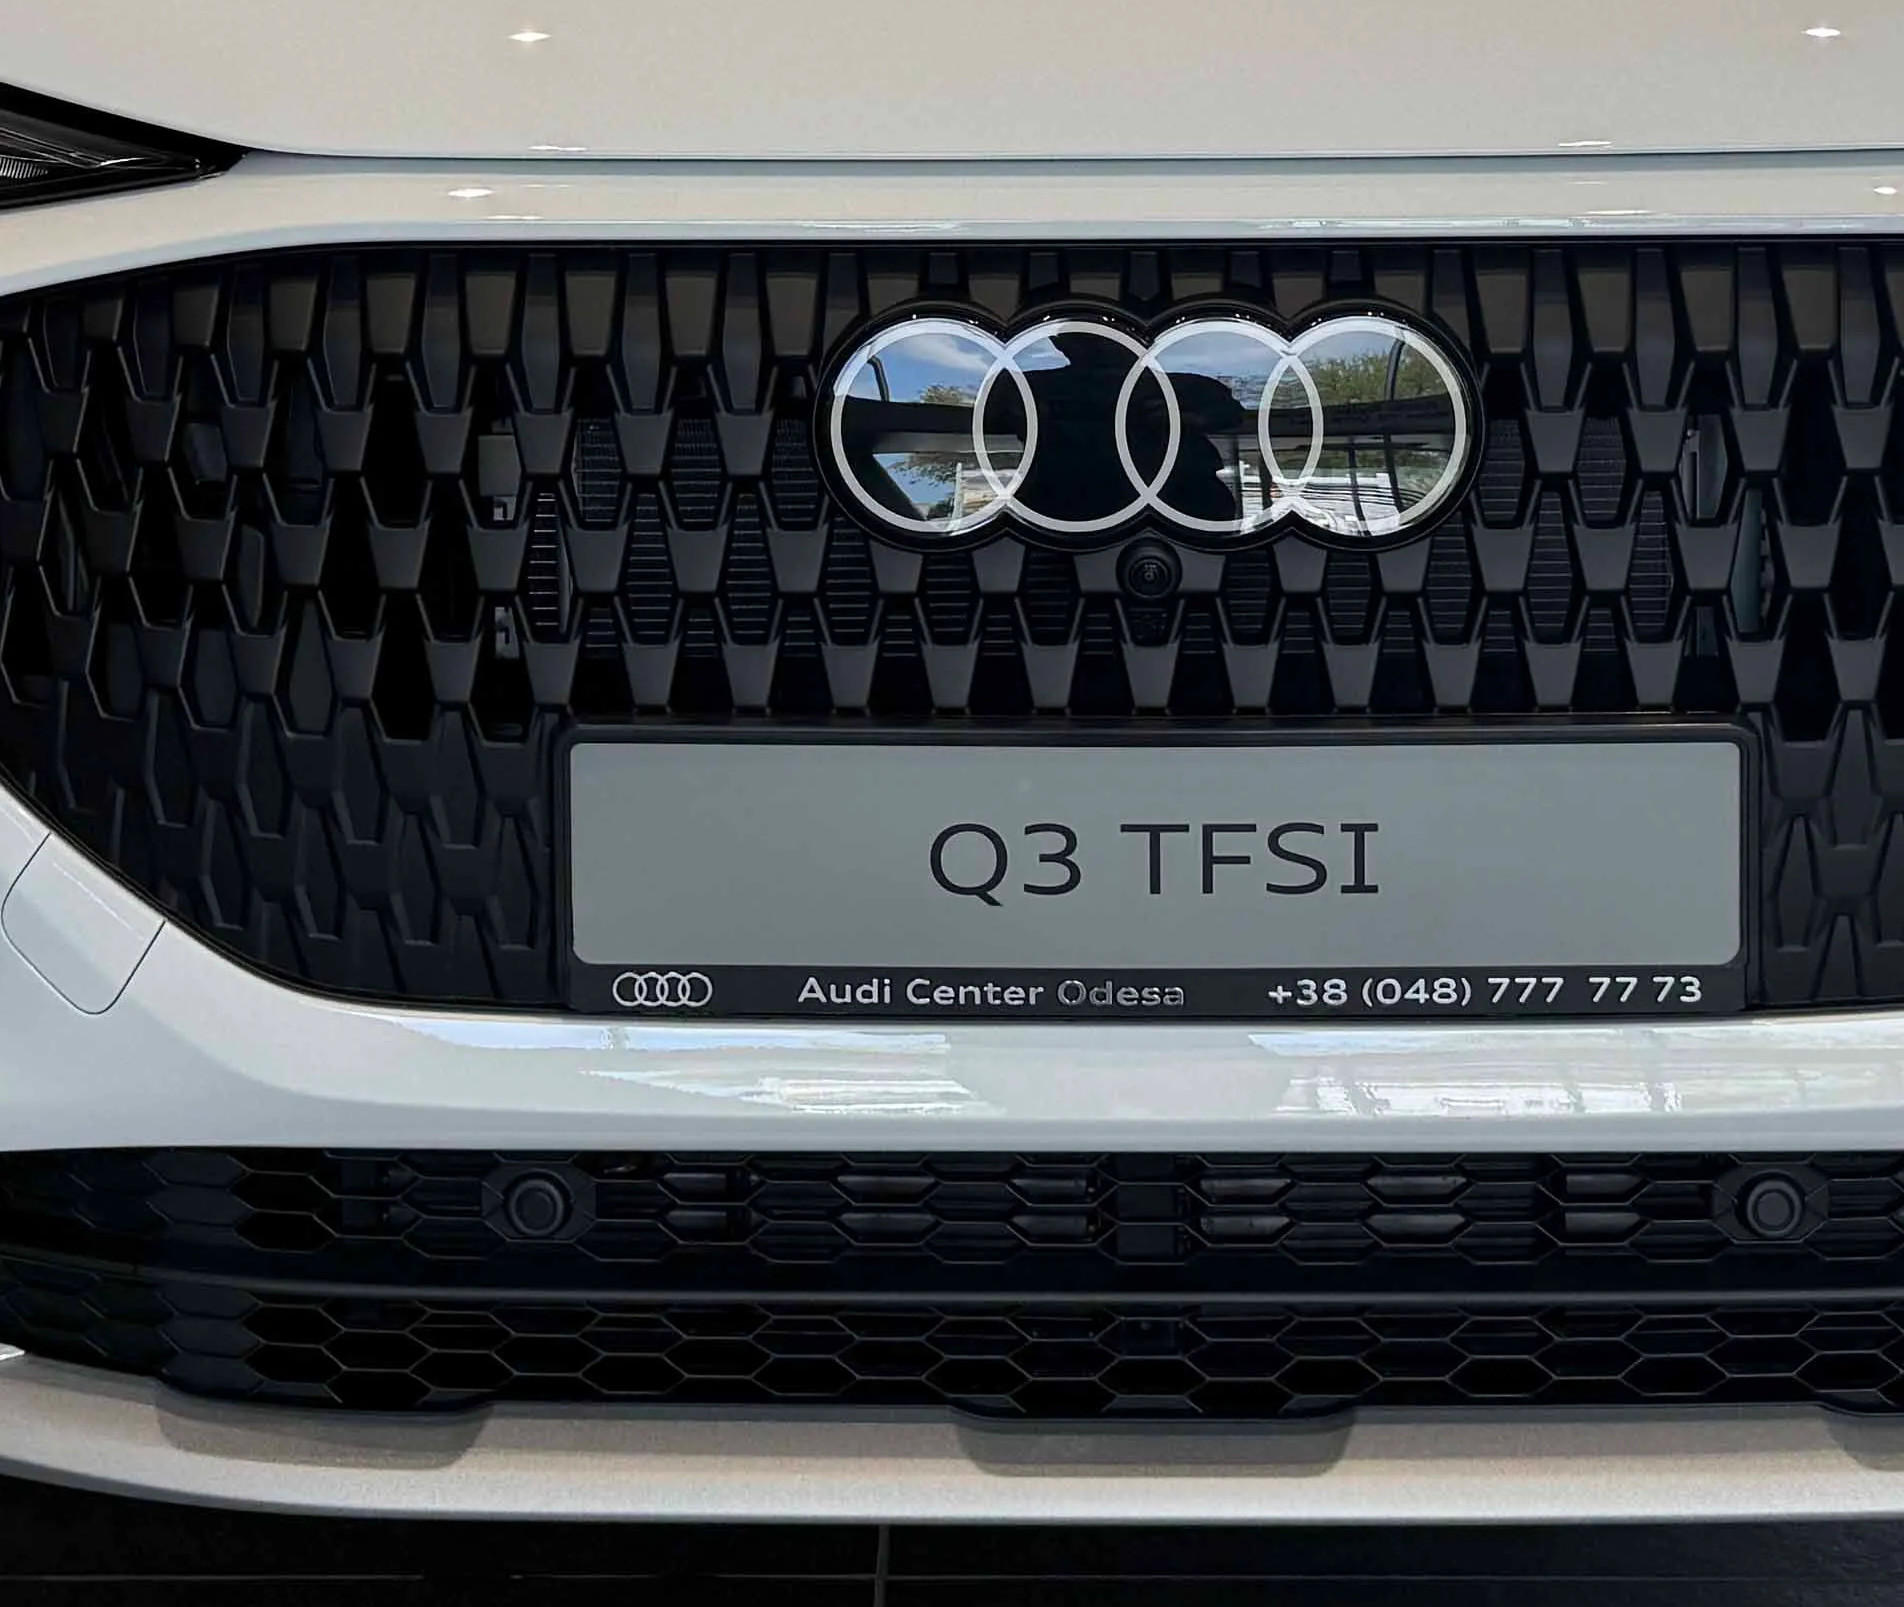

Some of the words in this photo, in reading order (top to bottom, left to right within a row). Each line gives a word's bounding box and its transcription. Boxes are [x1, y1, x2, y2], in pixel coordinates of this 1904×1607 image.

[929, 822, 1082, 907] Q3
[1119, 822, 1380, 895] TFSI
[798, 976, 892, 1004] Audi
[905, 978, 1044, 1006] Center
[1057, 979, 1185, 1006] Odesa
[1268, 977, 1348, 1006] +38
[1361, 976, 1472, 1007] (048)
[1487, 976, 1565, 1004] 777
[1589, 976, 1639, 1003] 77
[1652, 975, 1703, 1003] 73
